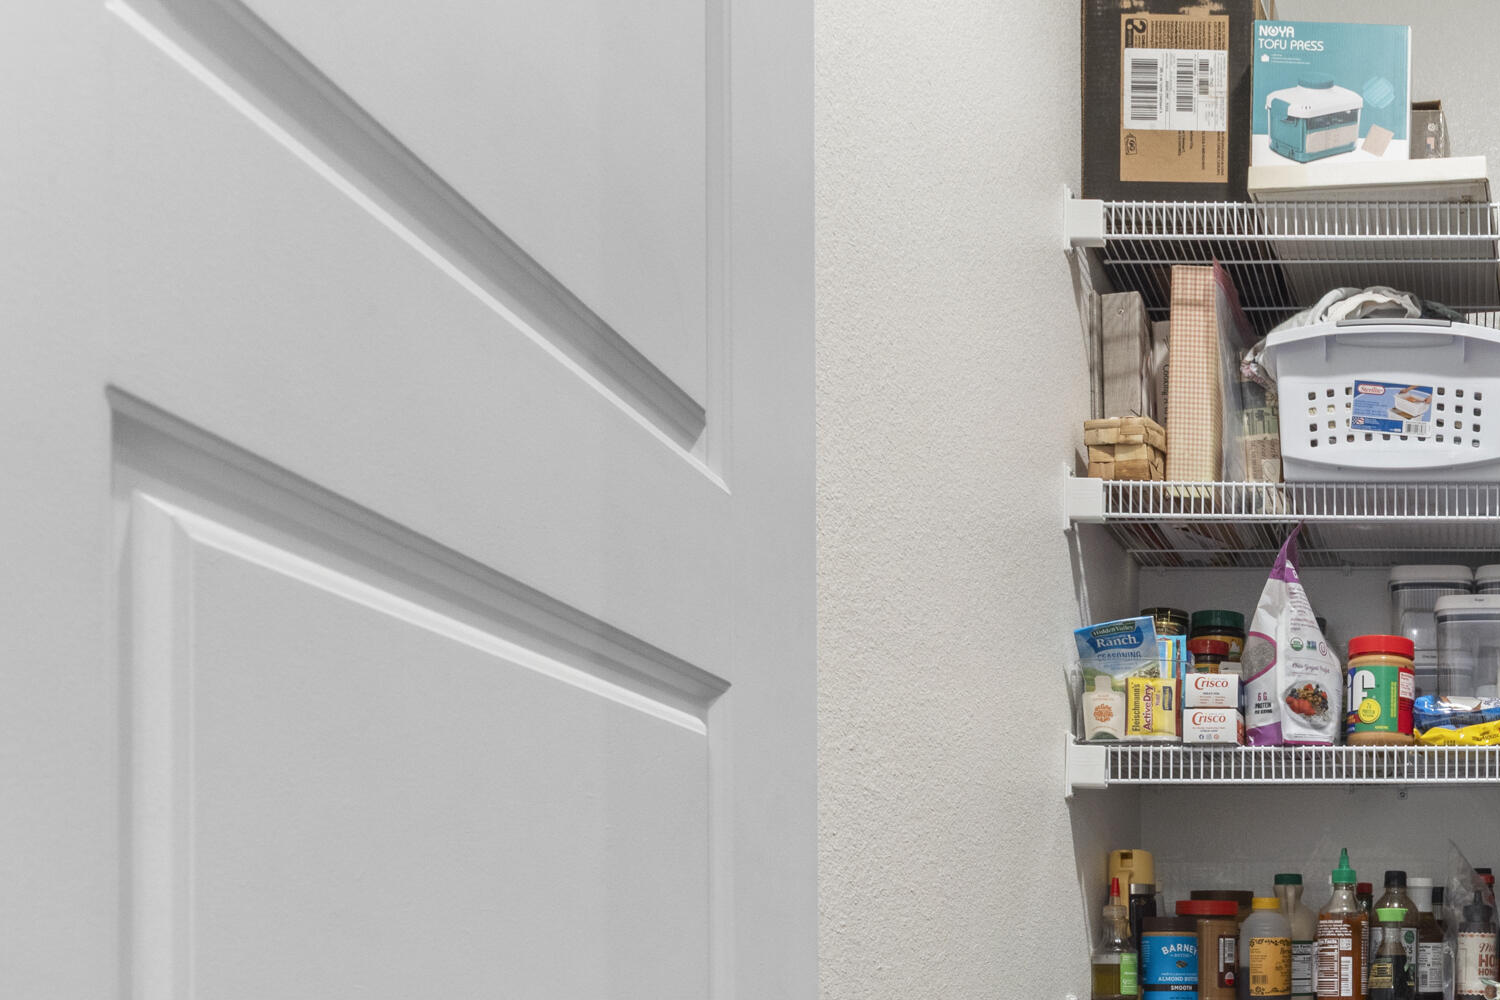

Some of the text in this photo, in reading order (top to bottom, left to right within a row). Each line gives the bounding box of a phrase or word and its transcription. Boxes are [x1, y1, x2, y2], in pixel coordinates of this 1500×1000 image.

[1259, 25, 1295, 37] NOYA
[1258, 38, 1324, 51] TOFU PRESS
[1096, 635, 1137, 648] Ranch
[1194, 677, 1229, 690] Crisco
[1132, 683, 1141, 732] Fleischmann's
[1192, 711, 1226, 725] Crisco
